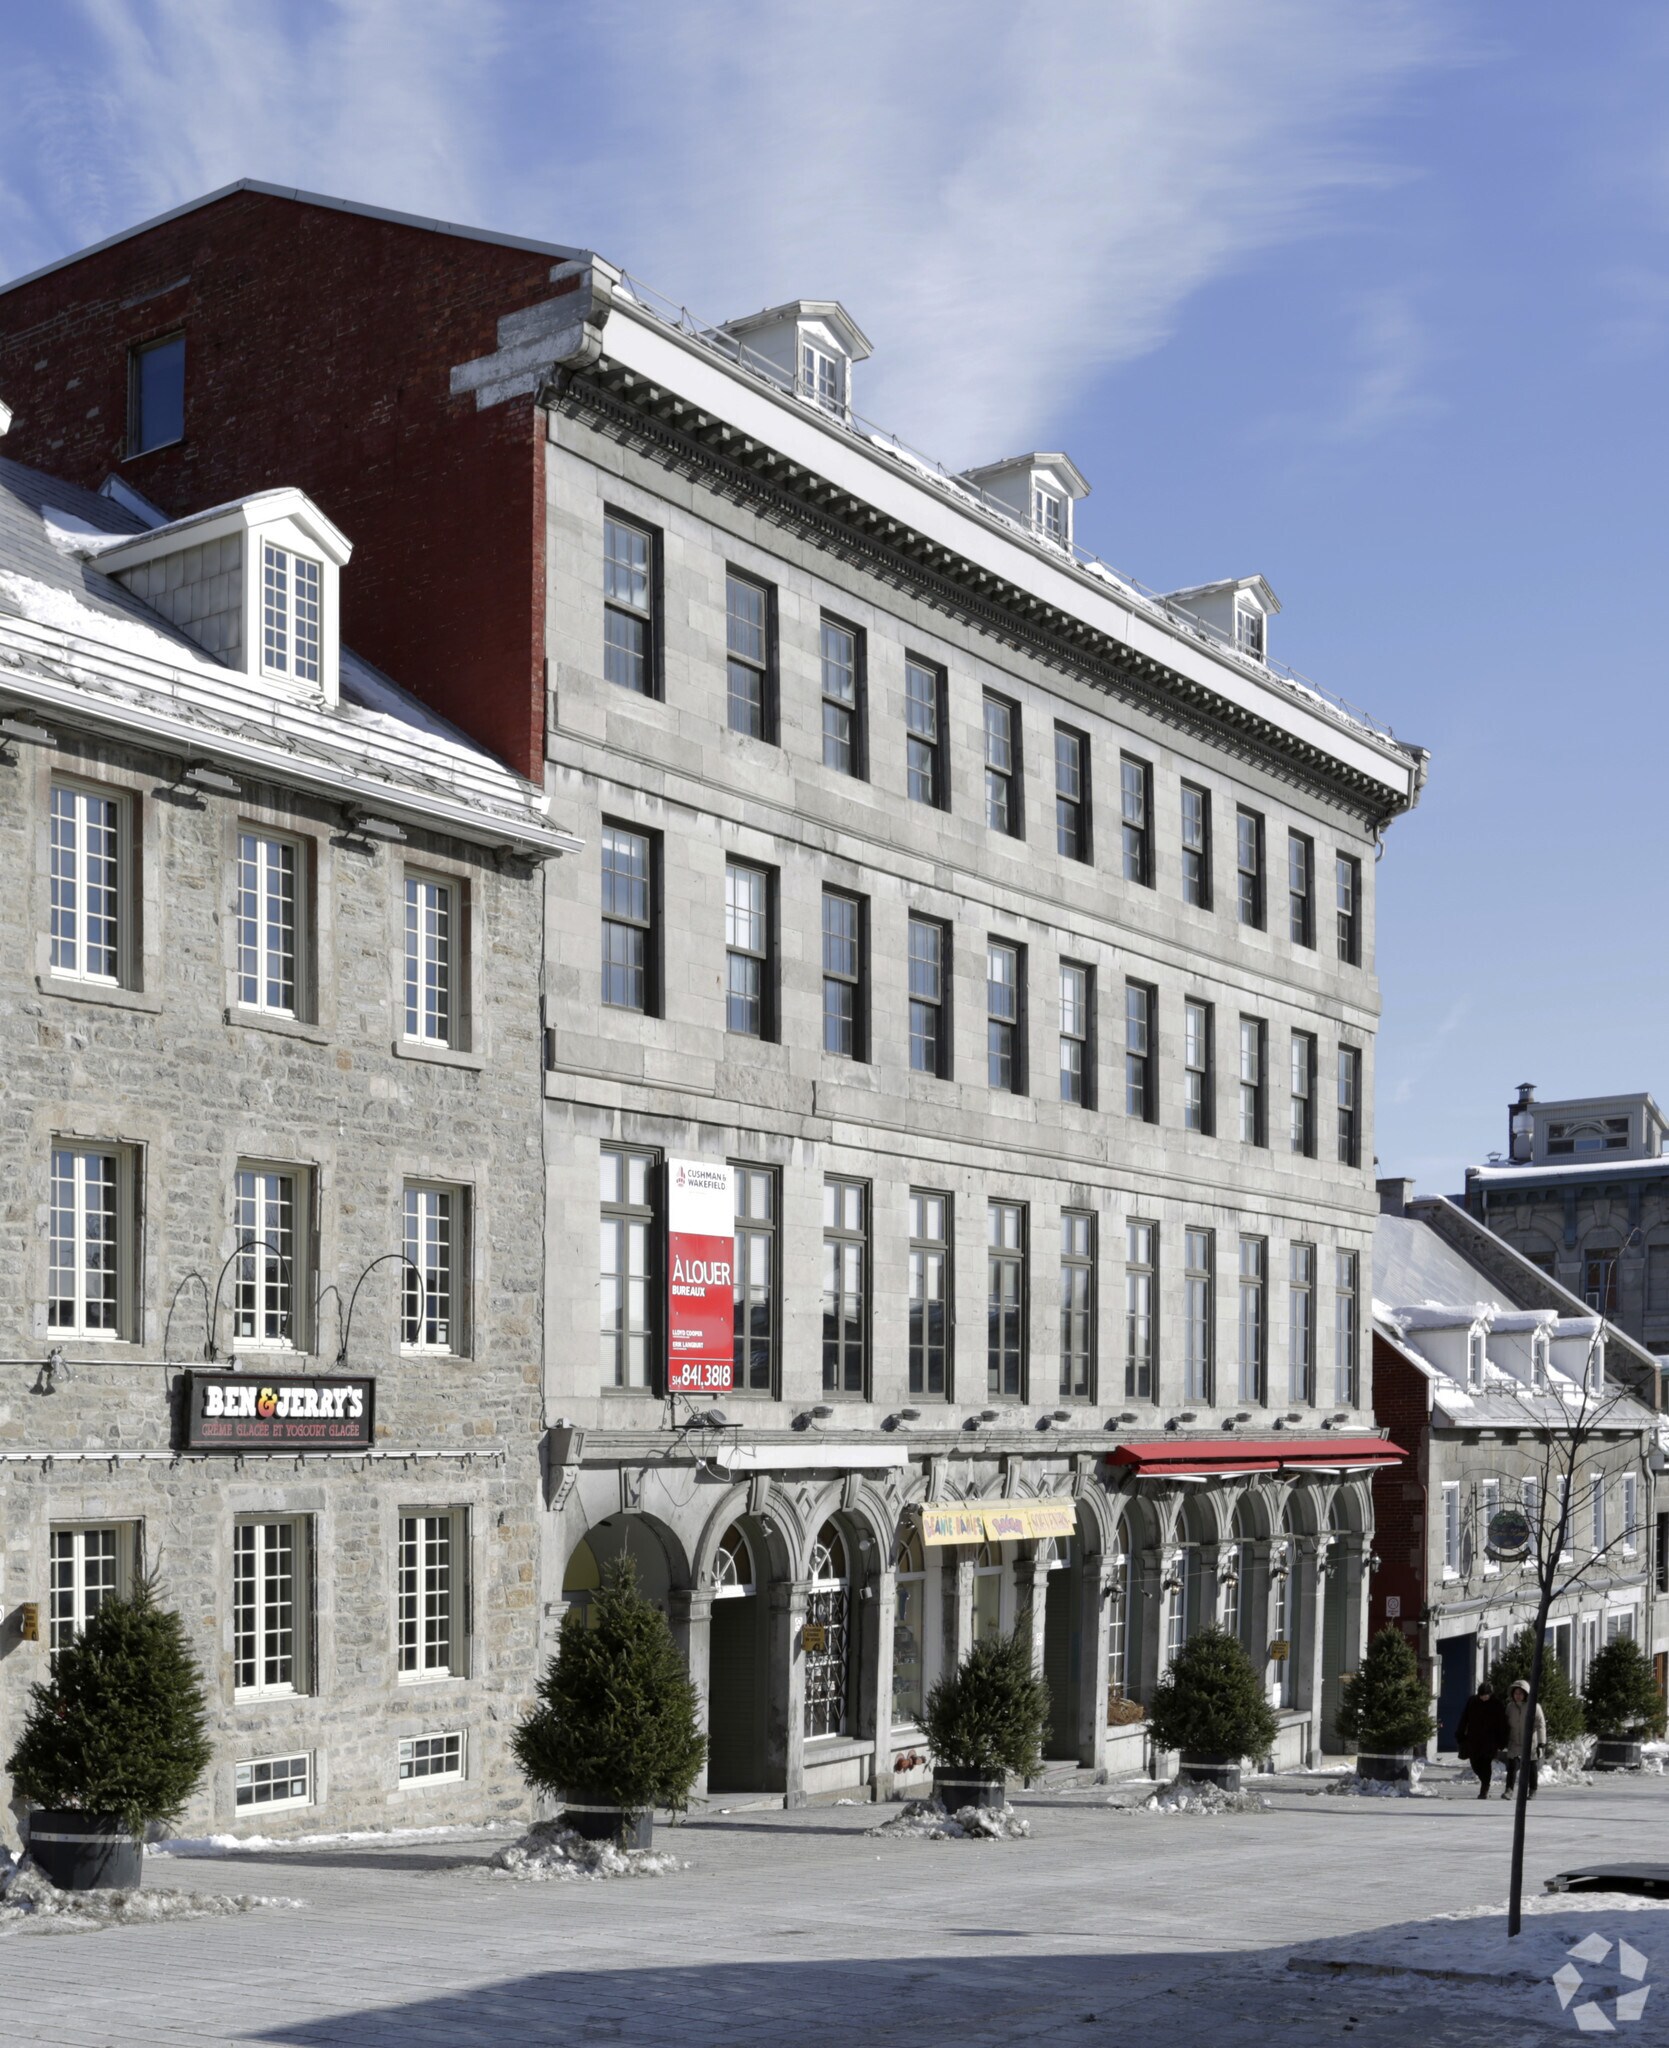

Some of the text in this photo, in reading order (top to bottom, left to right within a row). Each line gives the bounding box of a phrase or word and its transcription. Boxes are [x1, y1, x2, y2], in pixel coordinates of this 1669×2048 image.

[688, 1170, 721, 1181] CUSHMAN
[688, 1179, 726, 1190] WAKEFIELD
[672, 1254, 731, 1286] À LOUER
[672, 1285, 706, 1297] BUREAUX
[672, 1364, 731, 1386] 514 841.3818
[206, 1385, 257, 1417] BEN
[276, 1385, 364, 1418] JERRY'S
[202, 1421, 360, 1437] CRÈME GLACÉE ET YOGOURT GLACÉE
